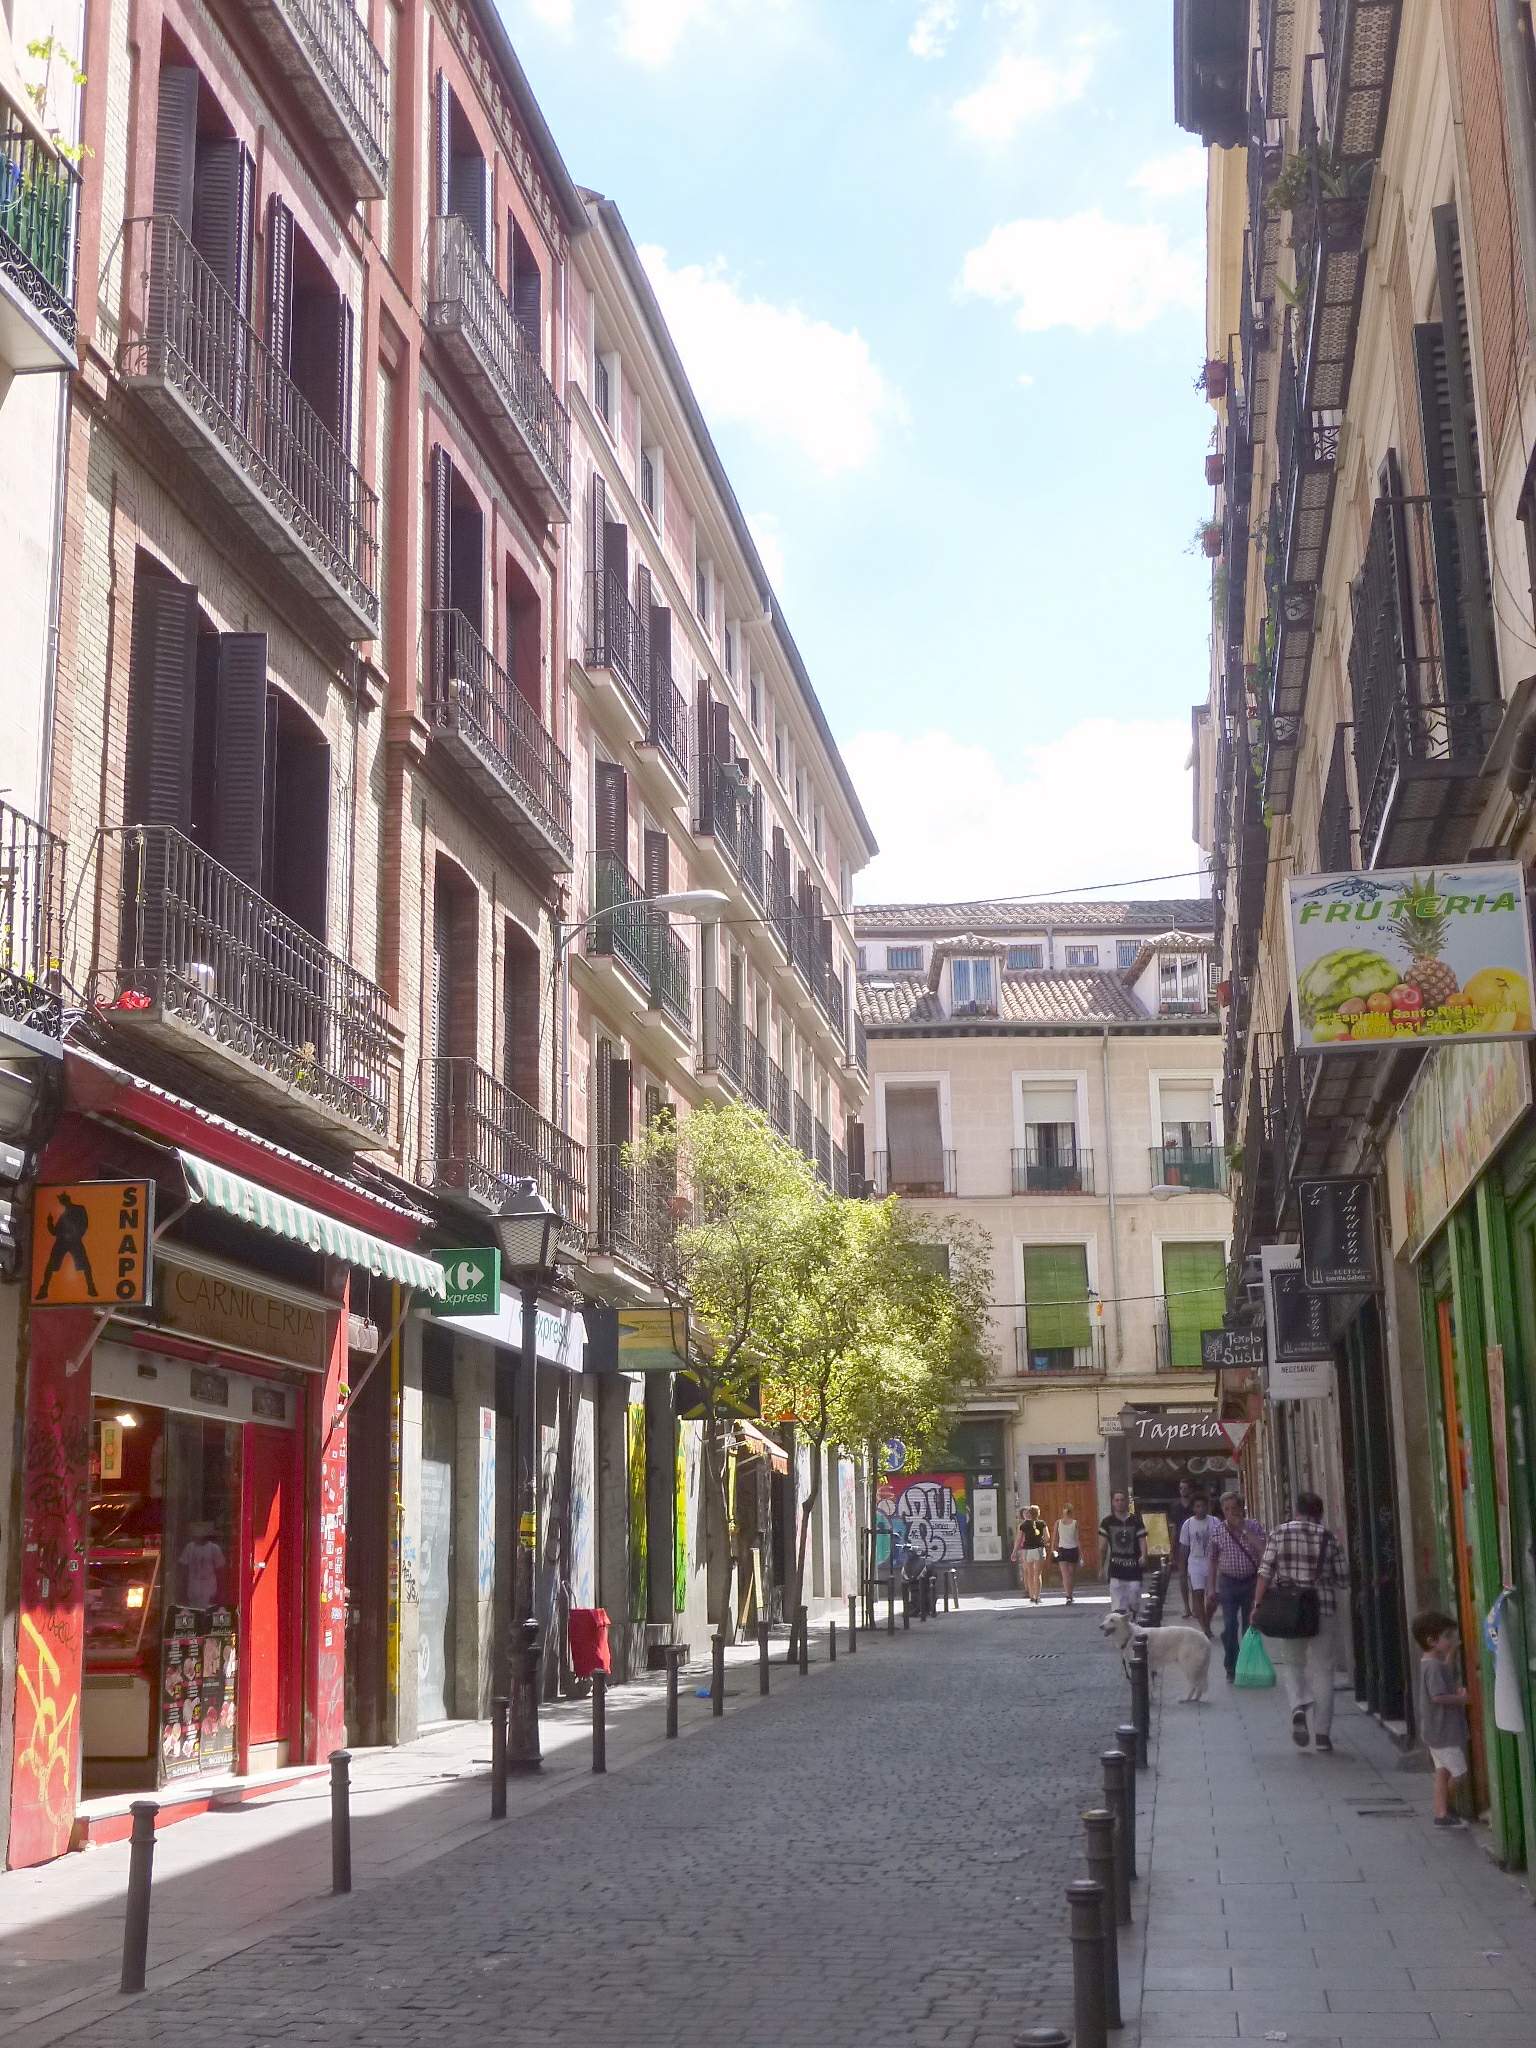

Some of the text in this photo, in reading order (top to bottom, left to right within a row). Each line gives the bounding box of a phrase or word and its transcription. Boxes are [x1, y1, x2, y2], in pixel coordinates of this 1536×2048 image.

[1299, 892, 1517, 925] FRUTERIA
[115, 1186, 137, 1300] SNAPO
[175, 1270, 317, 1340] CARNICERIA
[1135, 1415, 1224, 1449] Tapería
